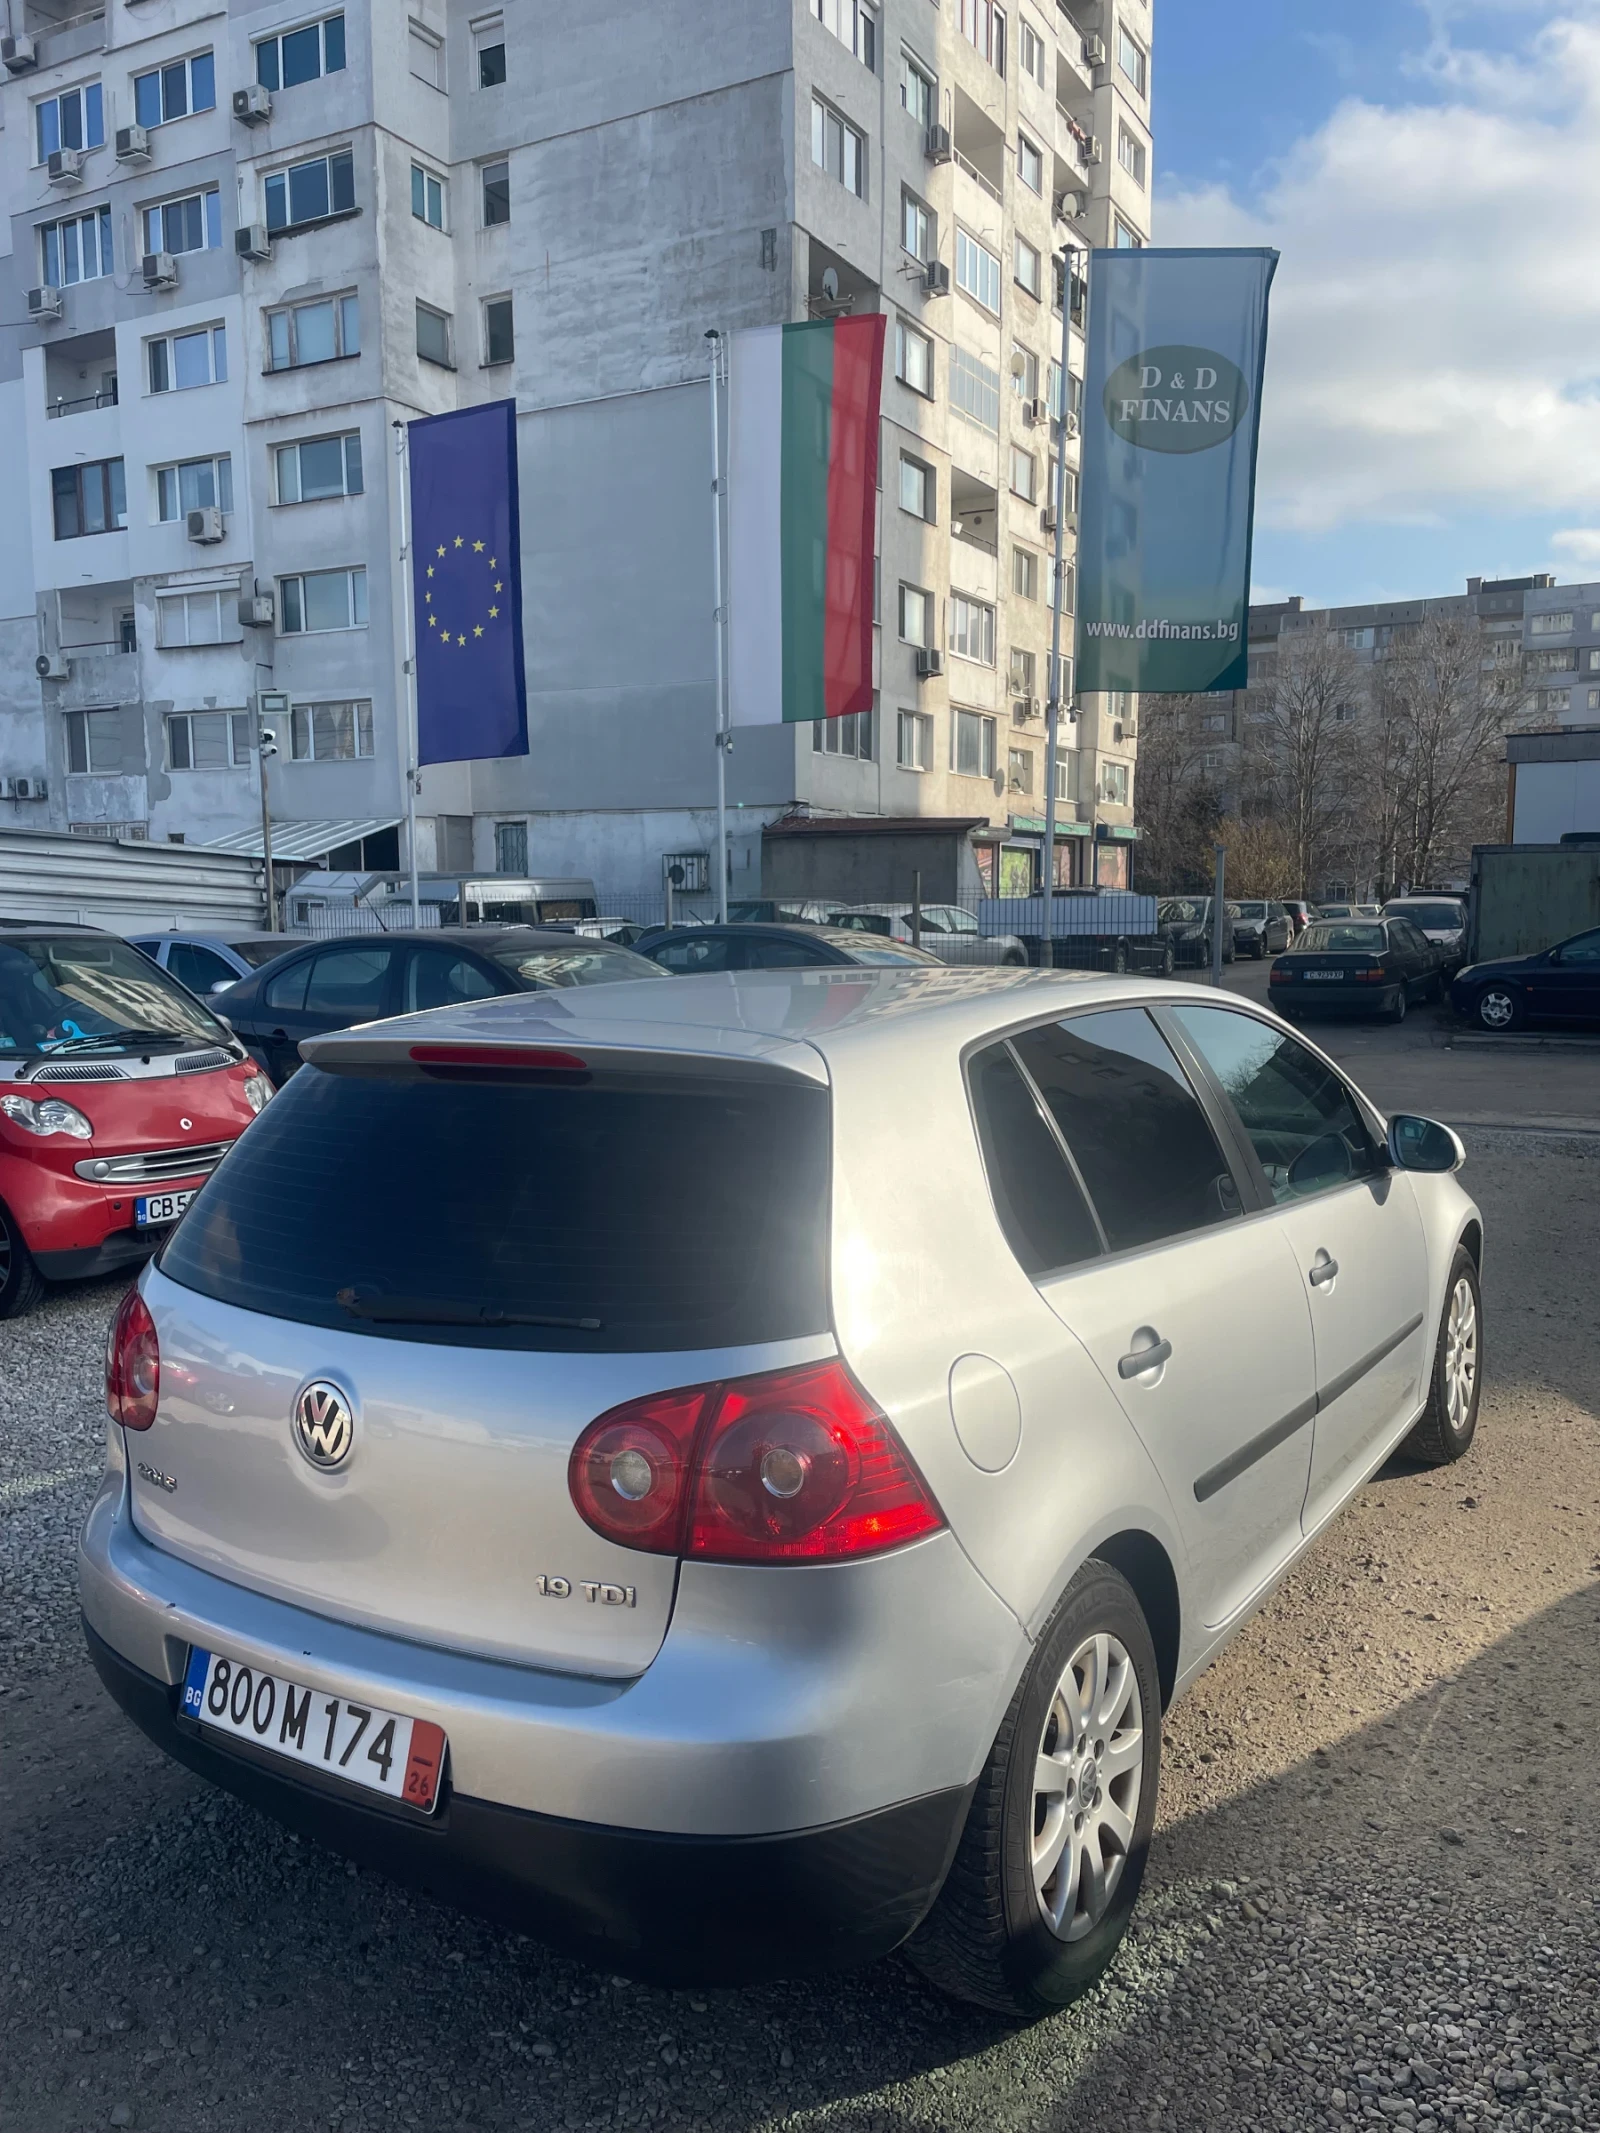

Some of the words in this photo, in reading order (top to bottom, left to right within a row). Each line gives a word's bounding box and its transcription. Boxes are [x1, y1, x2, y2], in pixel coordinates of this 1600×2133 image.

[1139, 366, 1162, 389] D
[1170, 371, 1186, 390] &
[1194, 367, 1217, 390] D
[1119, 398, 1230, 424] FINANS
[1086, 618, 1239, 642] www.ddfinans.bg
[150, 1197, 174, 1219] CB
[177, 1193, 196, 1214] 5
[580, 1580, 637, 1608] TDI
[185, 1686, 201, 1707] BG
[208, 1659, 275, 1735] 800
[279, 1684, 312, 1750] M
[324, 1700, 397, 1782] 174
[409, 1771, 429, 1797] 26
